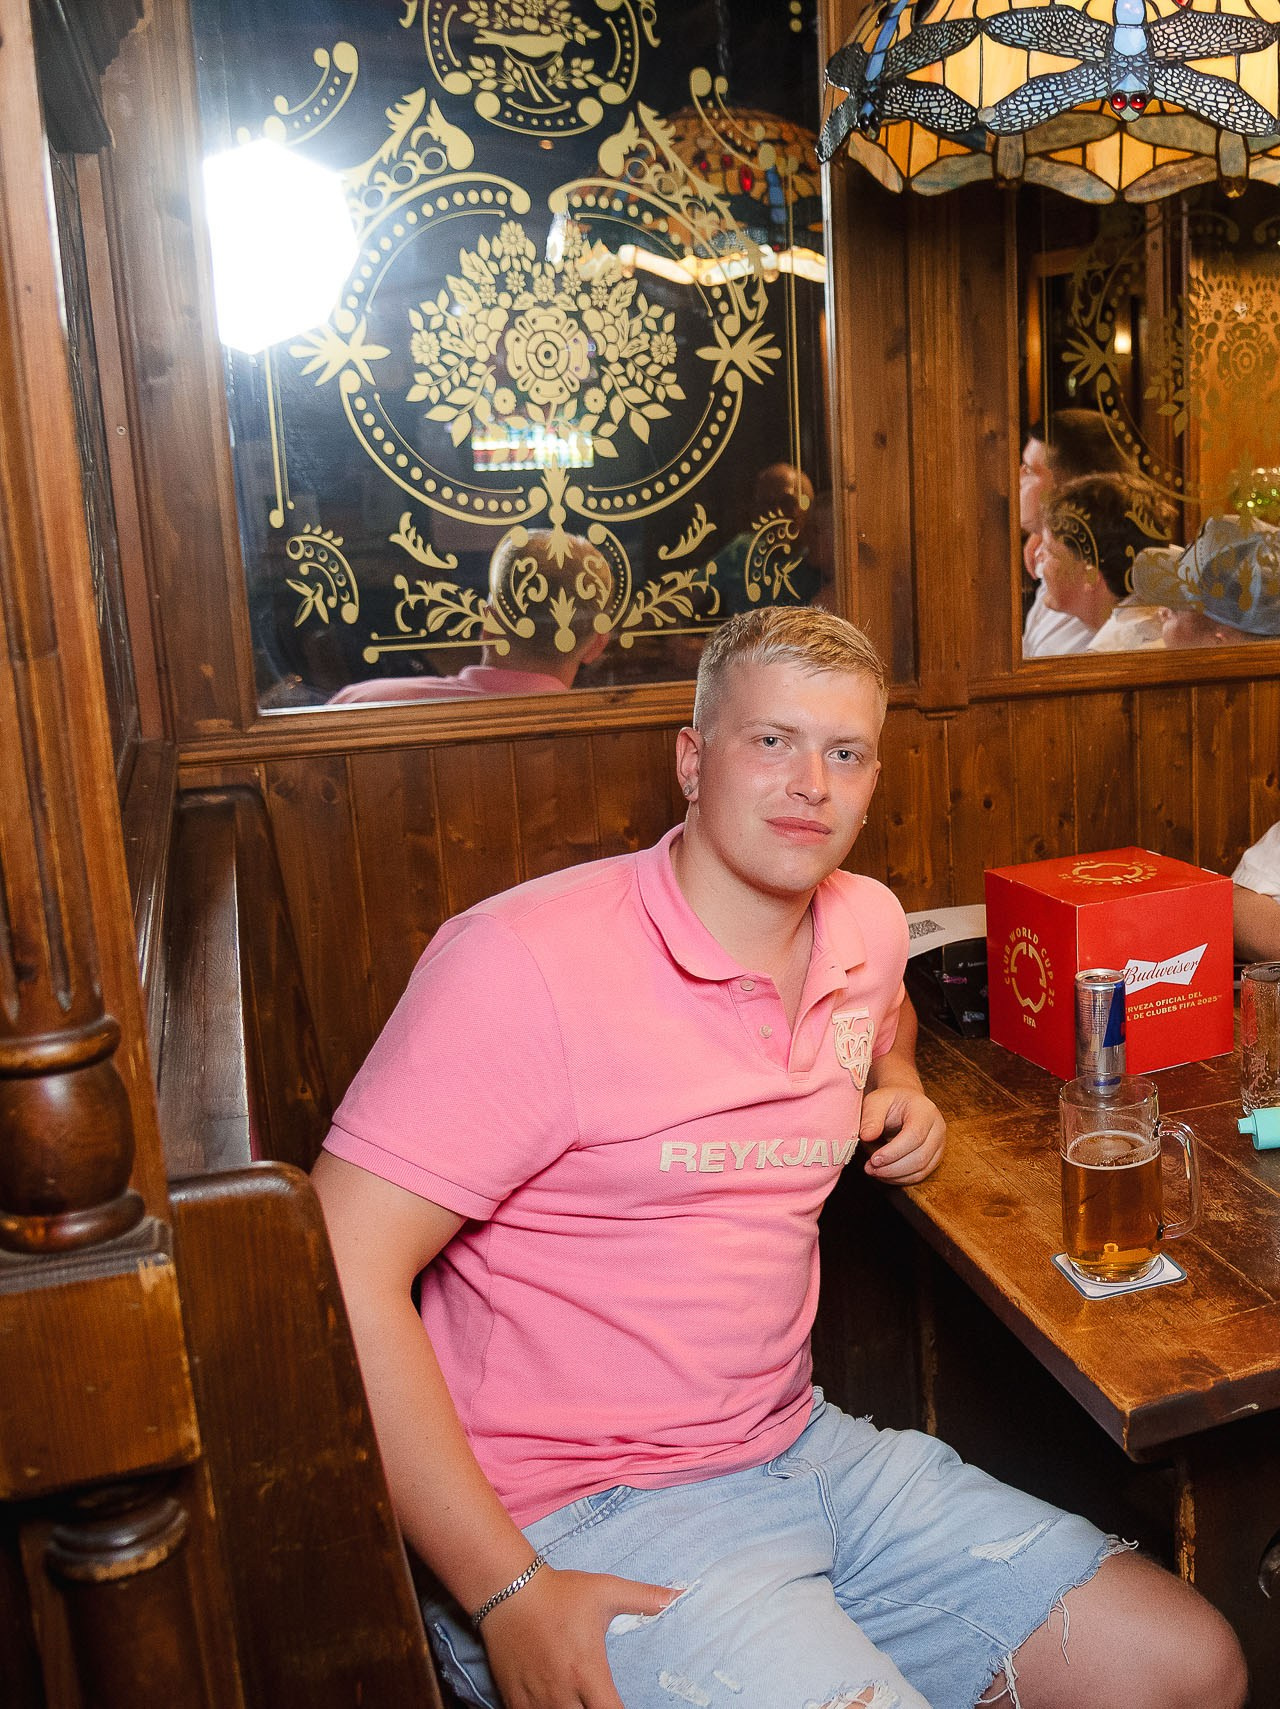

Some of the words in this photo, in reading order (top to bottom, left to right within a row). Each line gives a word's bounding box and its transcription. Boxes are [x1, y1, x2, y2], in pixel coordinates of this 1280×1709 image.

[1009, 927, 1039, 945] WORLD
[1041, 948, 1054, 980] CUP
[1124, 960, 1199, 985] Budweiser
[1126, 1002, 1154, 1013] RVEZA
[1155, 995, 1186, 1007] OFICIAL
[1188, 991, 1203, 1000] DEL
[1133, 1012, 1144, 1020] DE
[1146, 1005, 1177, 1017] CLUBES
[1179, 1001, 1196, 1010] FIFA
[1023, 1014, 1037, 1028] FIFA
